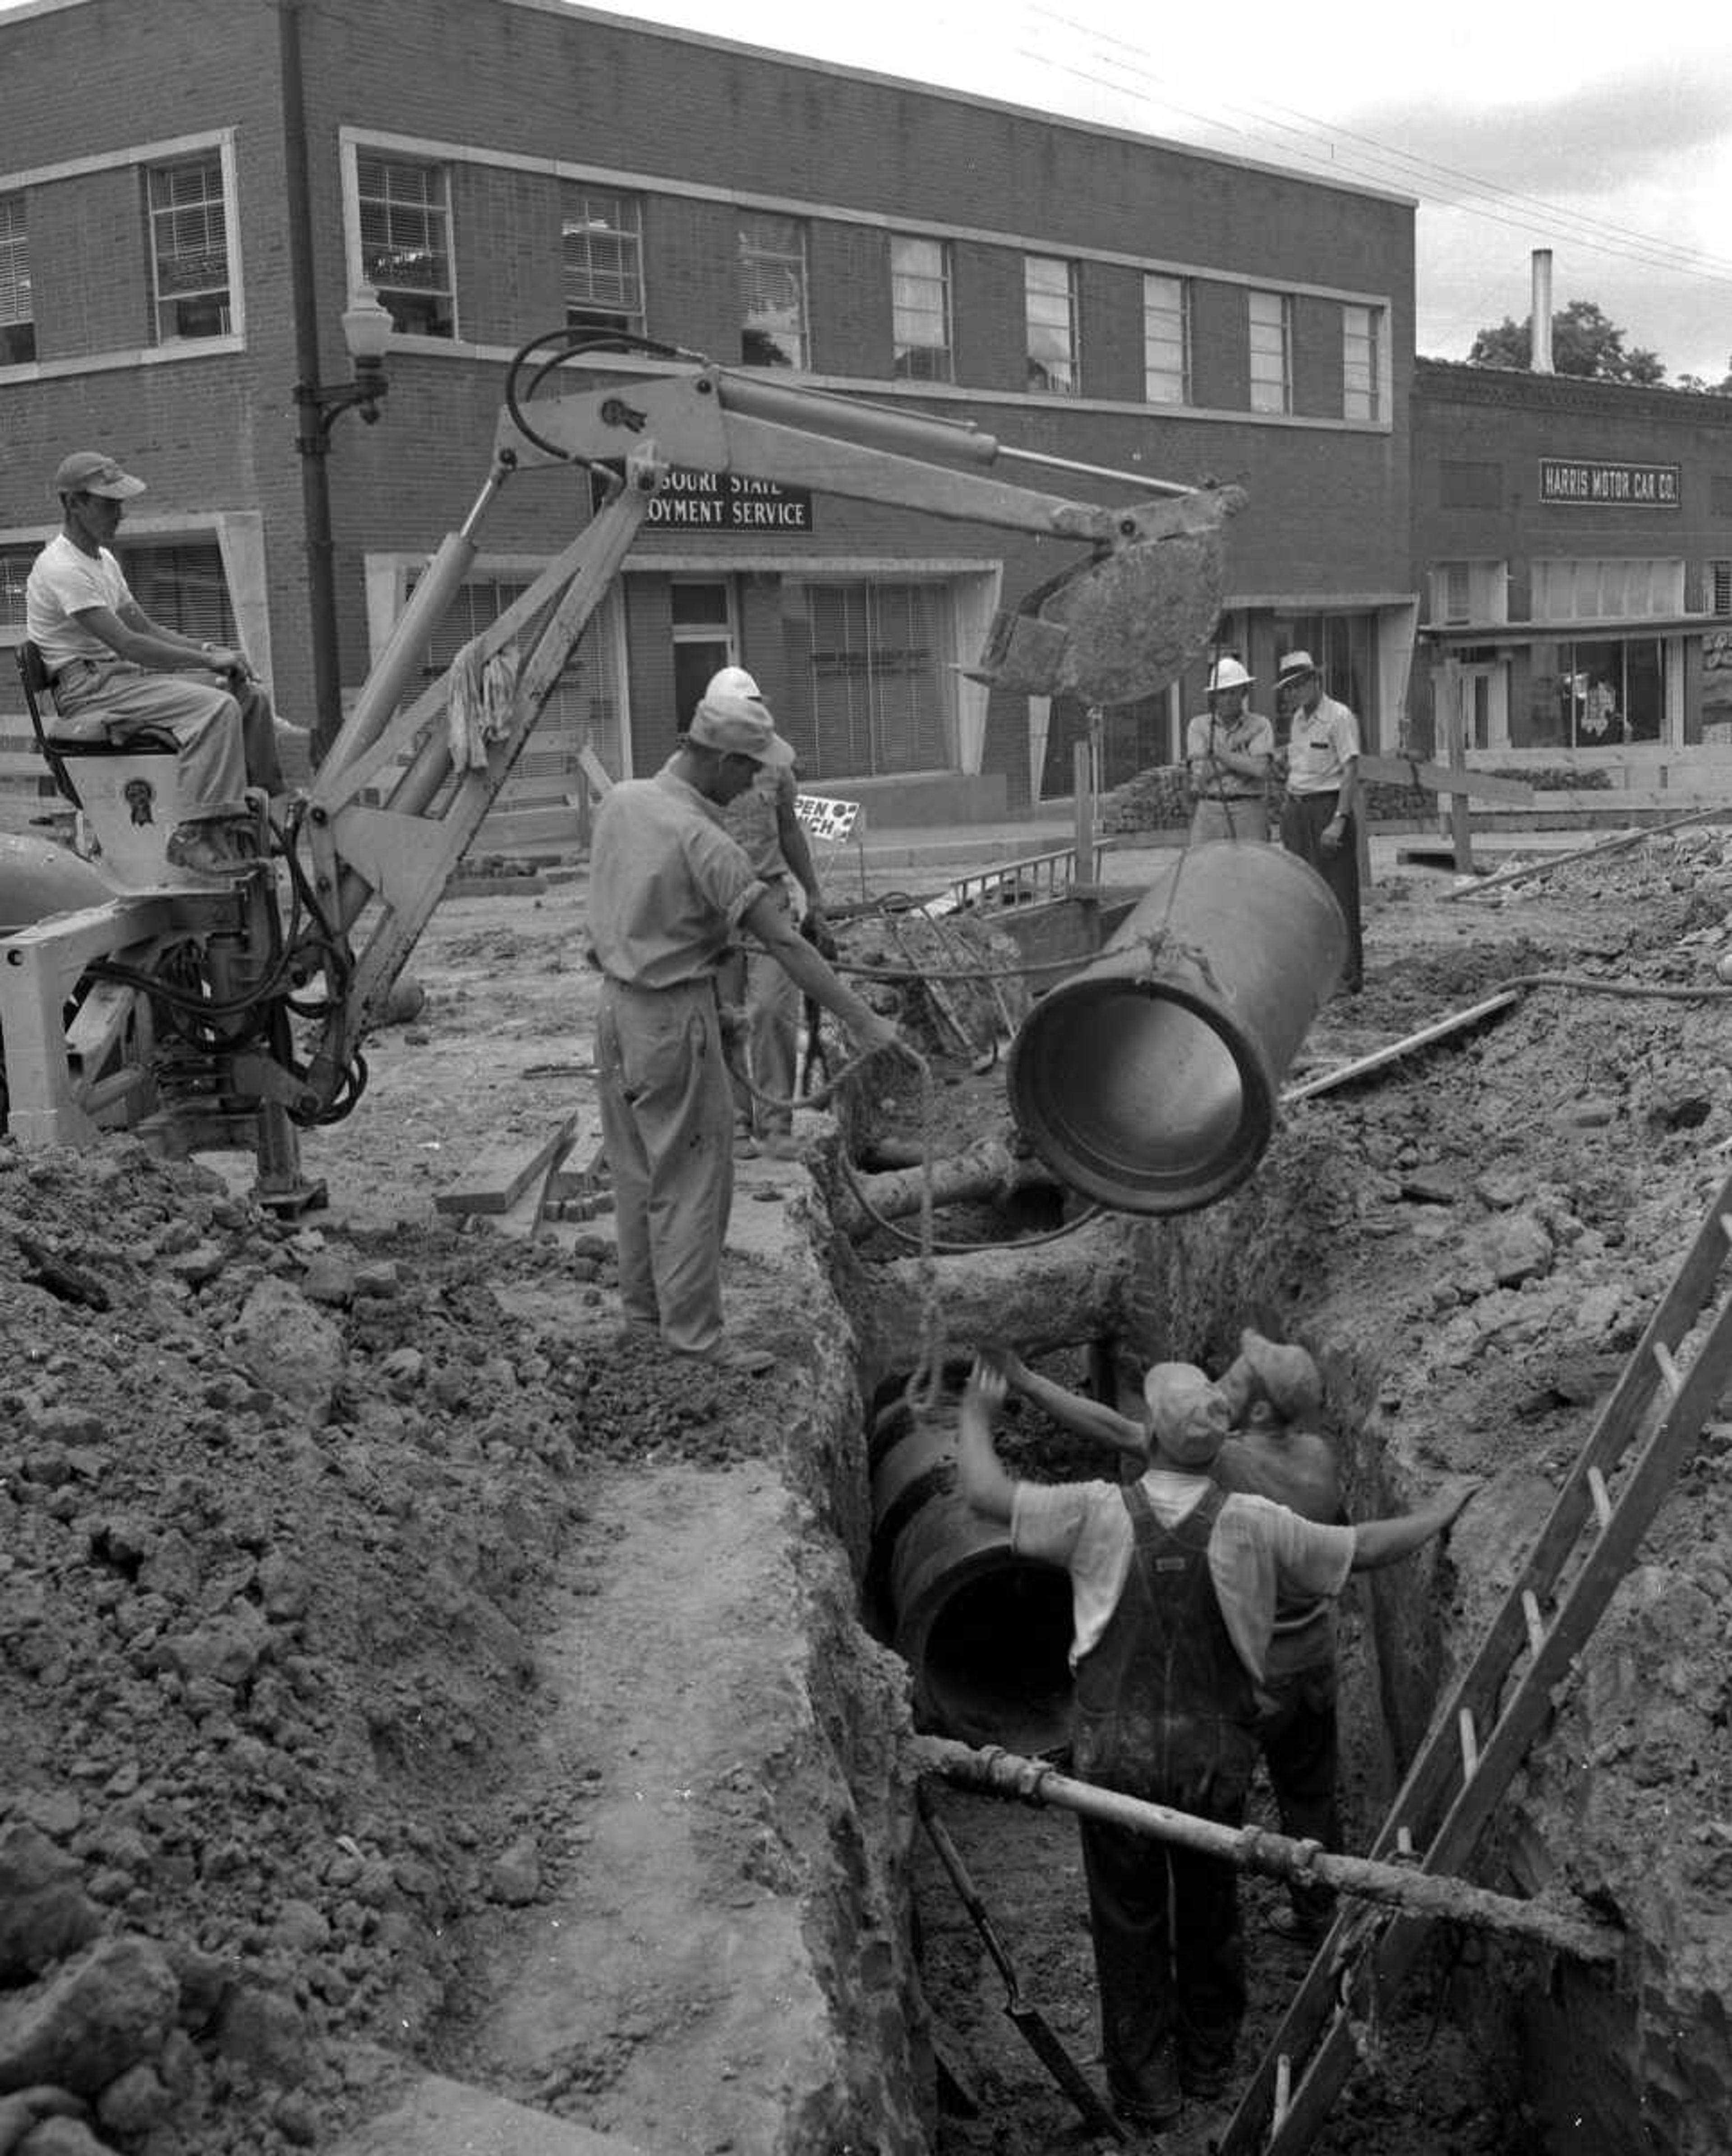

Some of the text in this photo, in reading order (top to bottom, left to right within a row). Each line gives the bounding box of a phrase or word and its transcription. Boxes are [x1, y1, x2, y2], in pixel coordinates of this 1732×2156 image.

[1546, 466, 1675, 499] HARRIS MOTOR CAR CO.
[646, 498, 806, 525] OYMENT SERVICE
[793, 799, 829, 816] PEN
